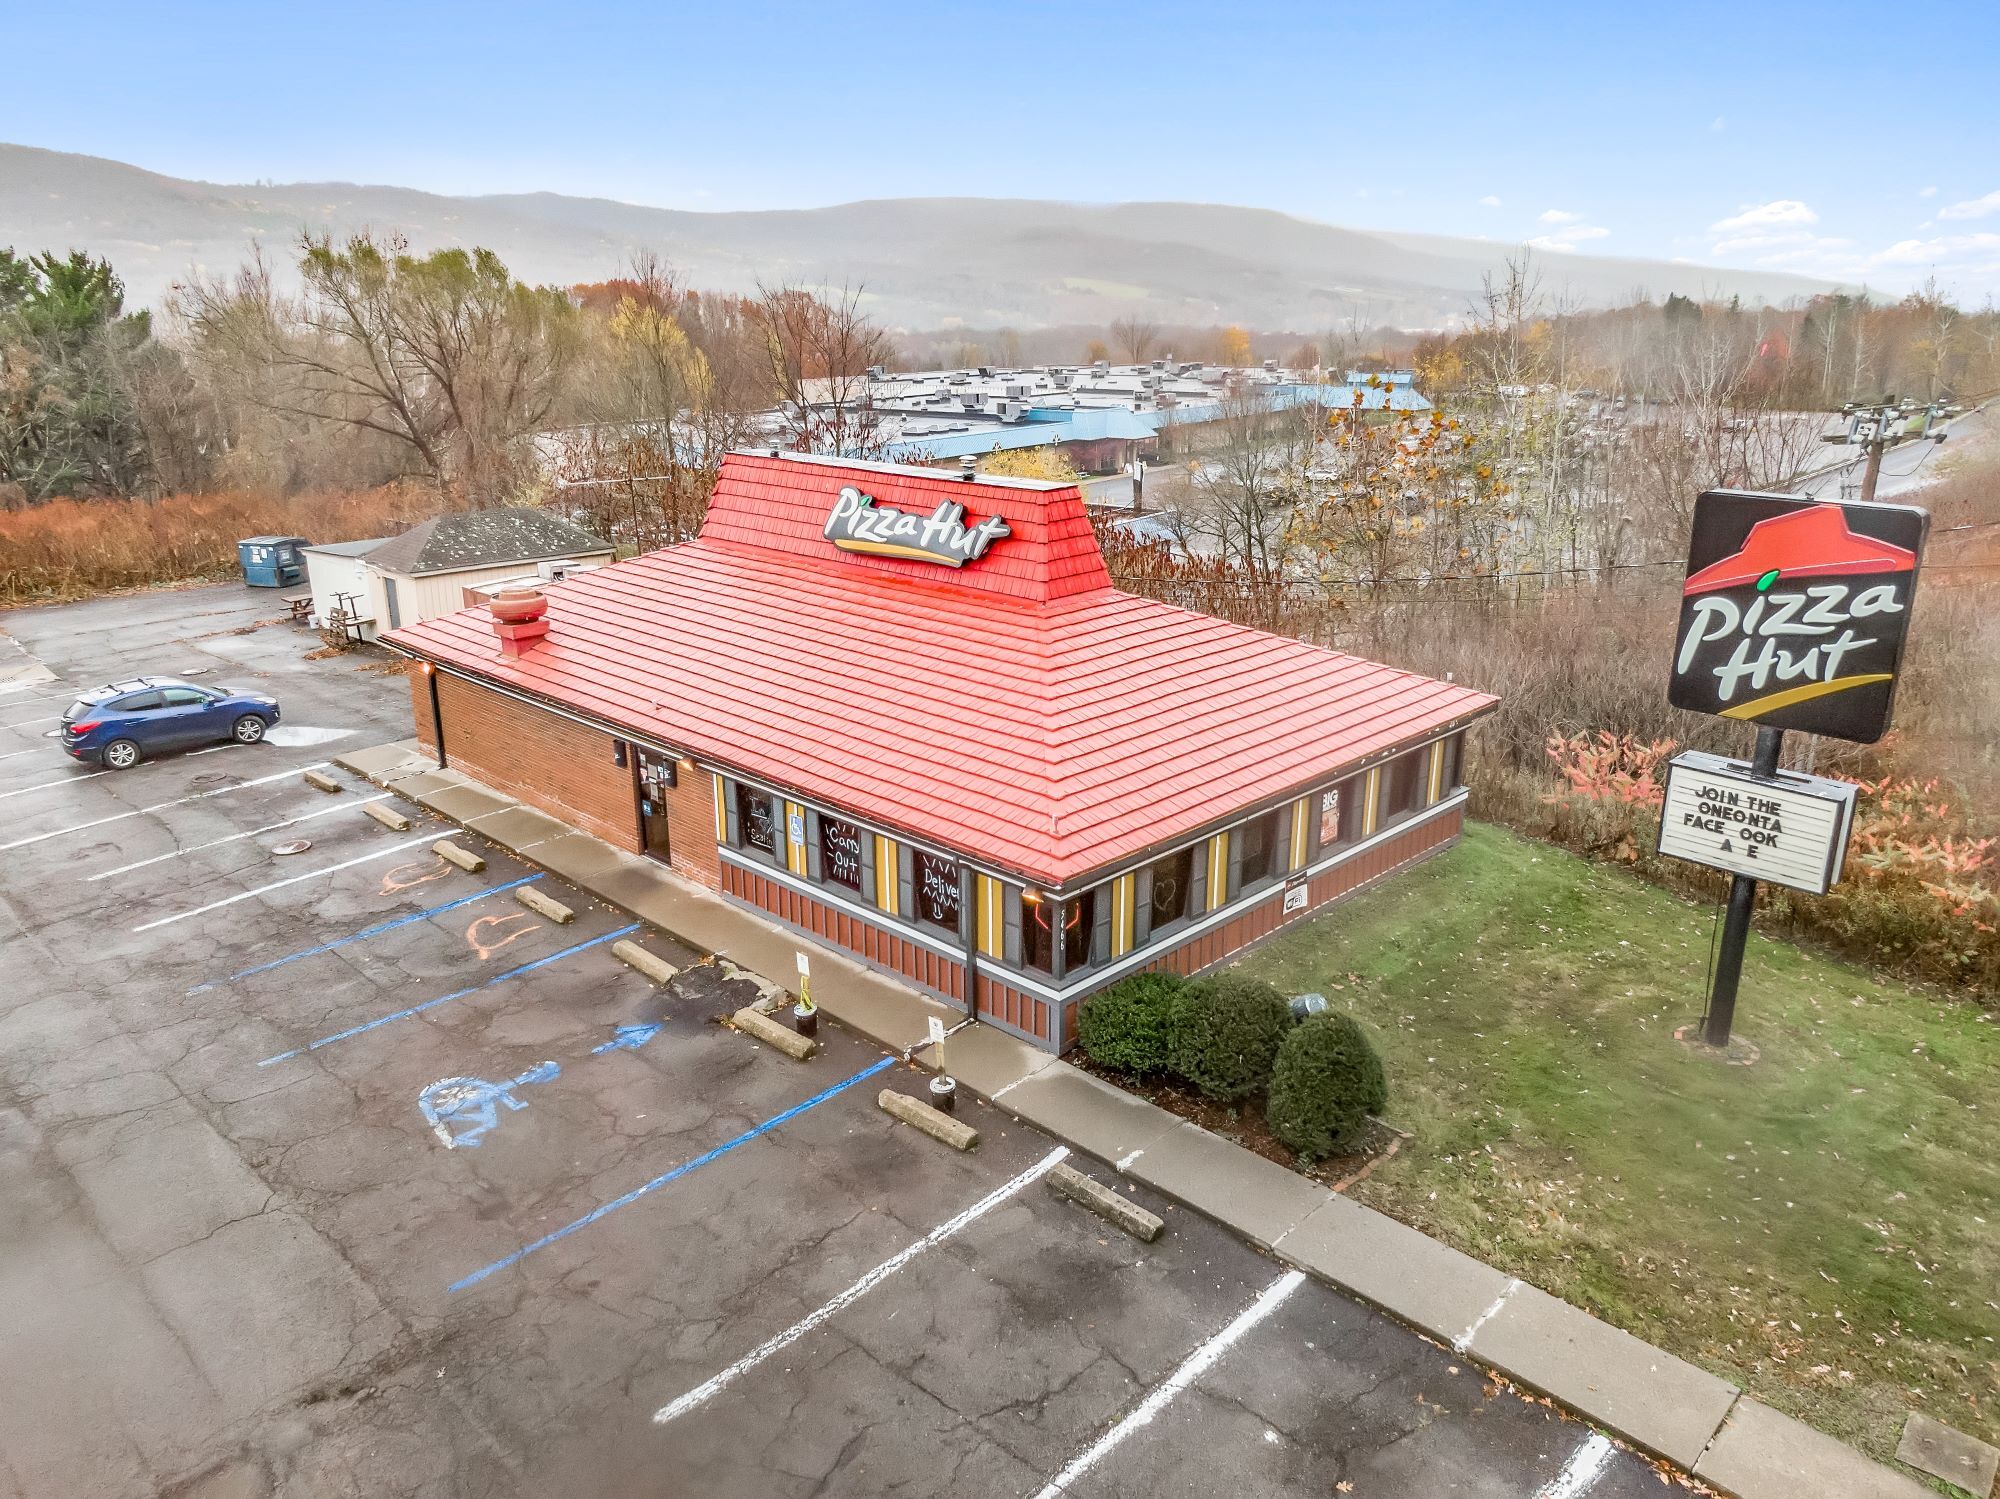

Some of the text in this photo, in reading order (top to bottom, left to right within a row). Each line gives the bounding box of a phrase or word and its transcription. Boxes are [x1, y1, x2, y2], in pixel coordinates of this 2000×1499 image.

[825, 487, 1008, 556] Pizza Hut
[1677, 570, 1904, 675] Pizza
[1713, 629, 1878, 701] Hut
[1695, 786, 1781, 816] JOIN THE
[1698, 801, 1782, 833] ONEONTA
[829, 827, 860, 853] Carry
[1683, 812, 1778, 848] FACE OOK
[835, 851, 857, 871] Out
[1720, 838, 1758, 858] A E
